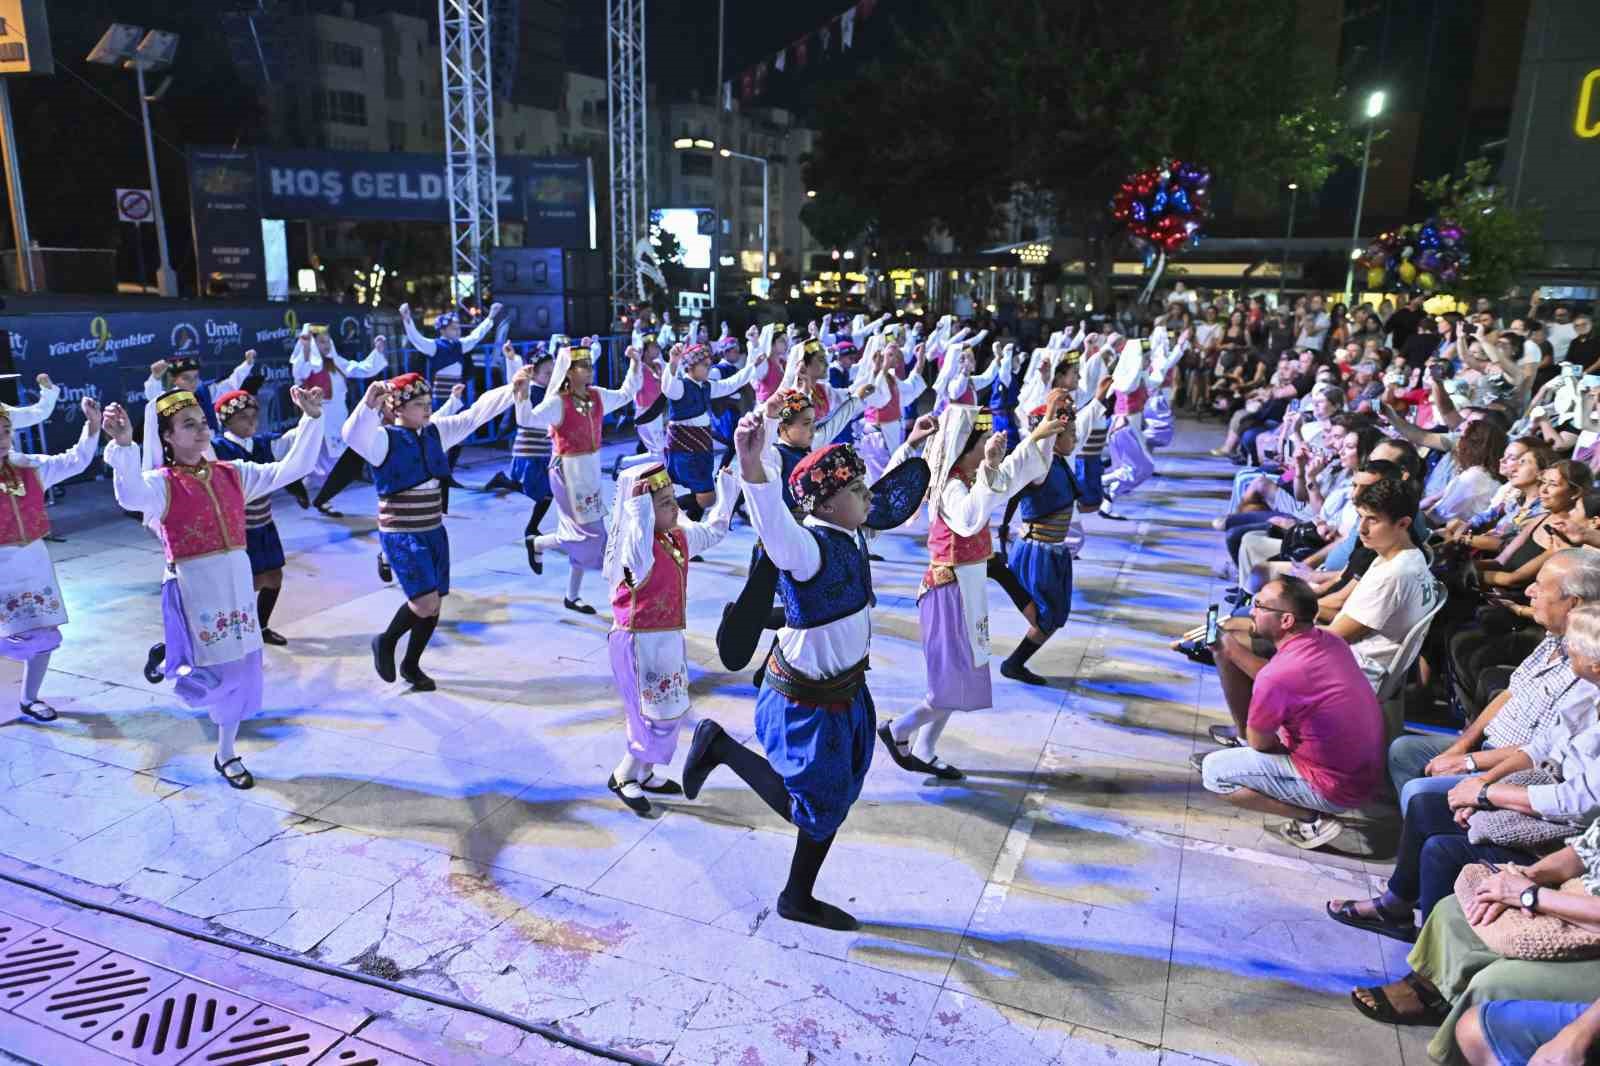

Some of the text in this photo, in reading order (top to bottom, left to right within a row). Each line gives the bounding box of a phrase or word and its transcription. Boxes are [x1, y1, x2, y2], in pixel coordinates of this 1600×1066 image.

[270, 168, 343, 204] HOŞ
[352, 171, 513, 203] GELDİZ
[205, 319, 239, 337] Ümit
[48, 336, 98, 357] Yöreler
[105, 333, 156, 352] Renkler
